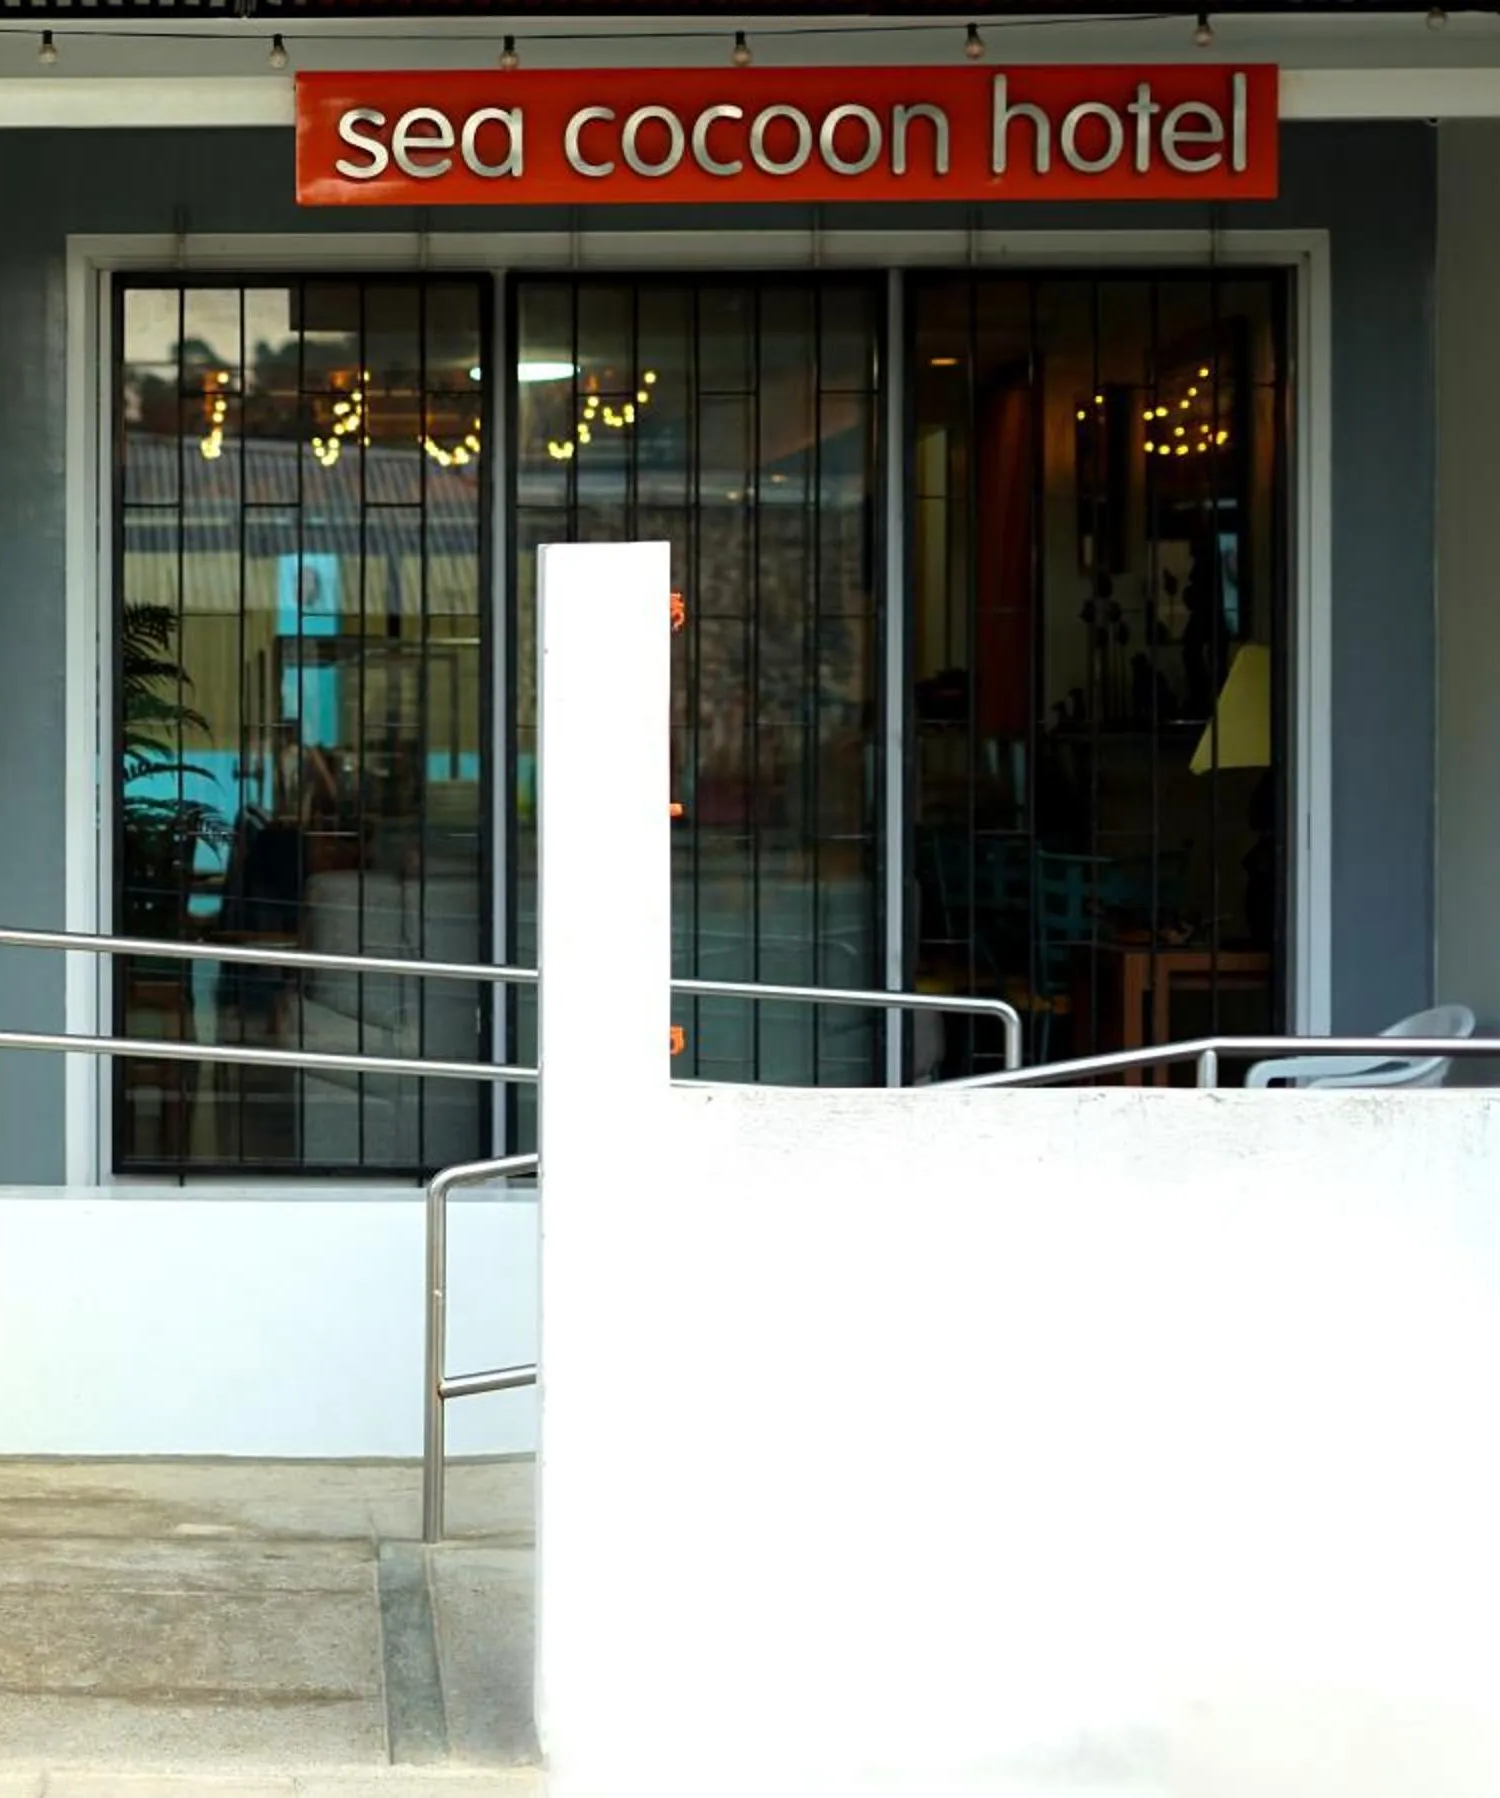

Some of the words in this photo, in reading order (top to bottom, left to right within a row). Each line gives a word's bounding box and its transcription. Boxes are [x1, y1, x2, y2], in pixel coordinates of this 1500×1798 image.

[334, 107, 525, 179] sea
[563, 104, 950, 178] cocoon
[992, 73, 1248, 174] hotel
